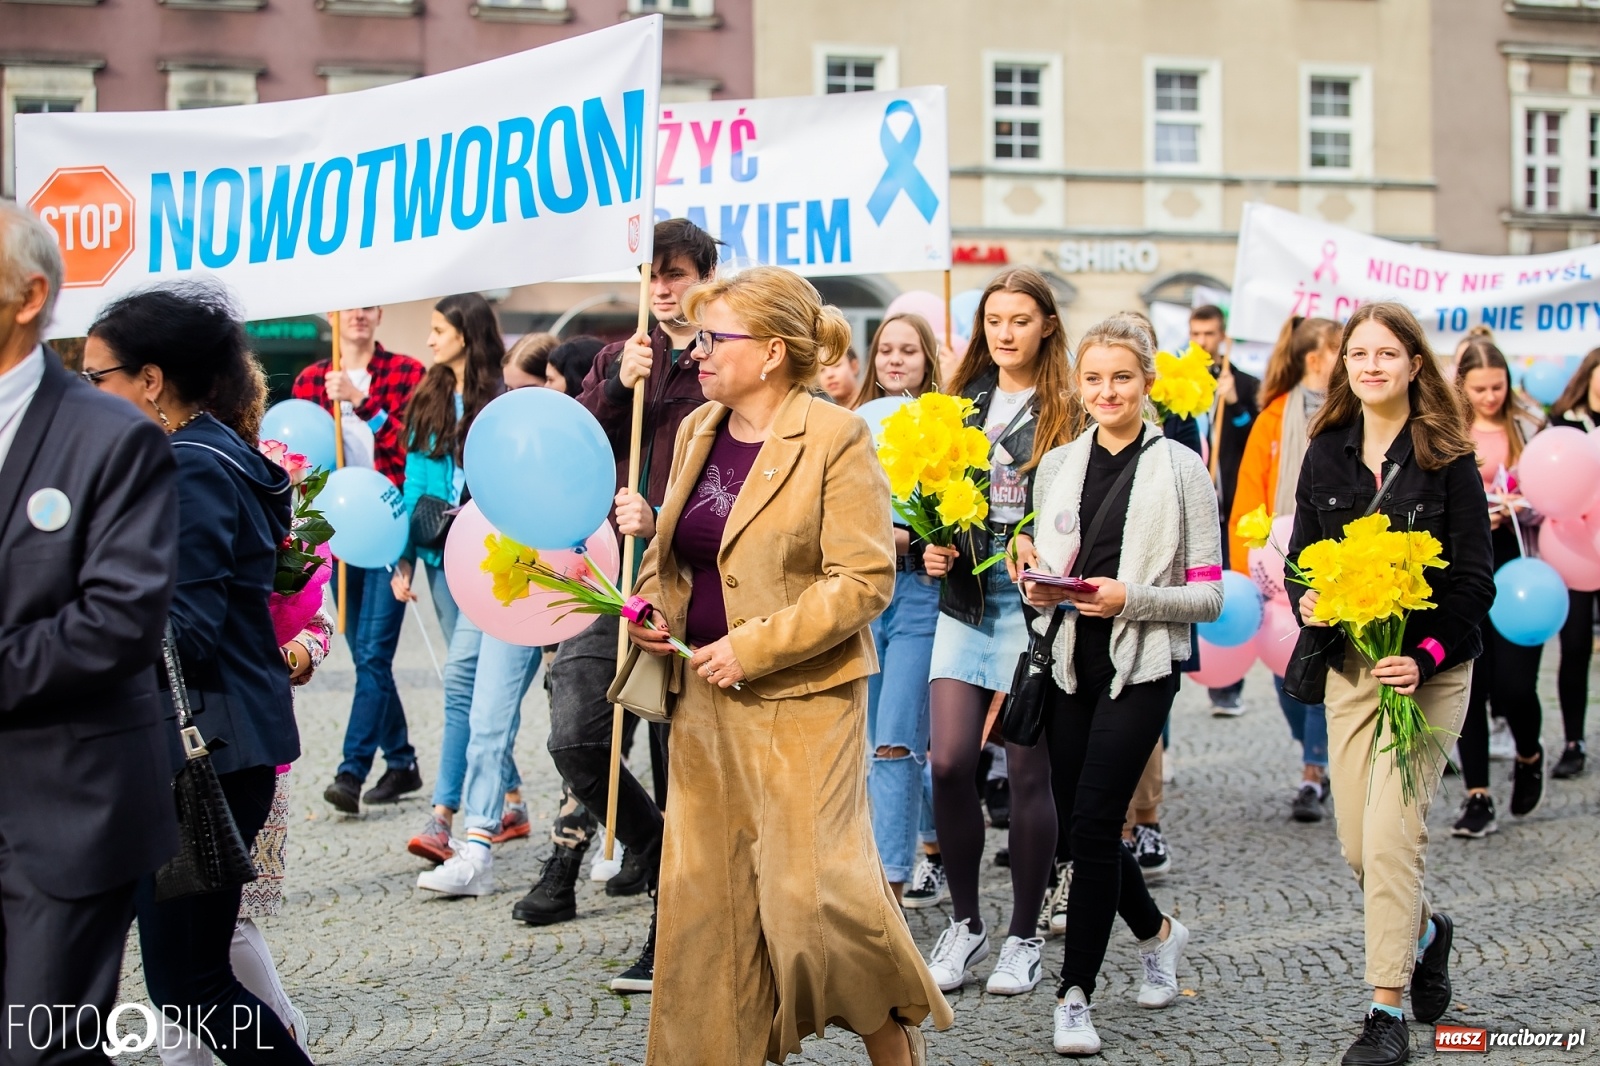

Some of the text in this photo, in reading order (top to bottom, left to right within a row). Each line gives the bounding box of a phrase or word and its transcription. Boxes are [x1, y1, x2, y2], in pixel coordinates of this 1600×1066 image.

[655, 108, 758, 185] ŻYĆ
[40, 89, 645, 273] STOP NOWOTWOROM
[1058, 240, 1158, 273] SHIRO
[1367, 258, 1592, 293] NIGDY NIE MYŚL
[1436, 306, 1468, 332] TO
[1482, 305, 1525, 331] NIE
